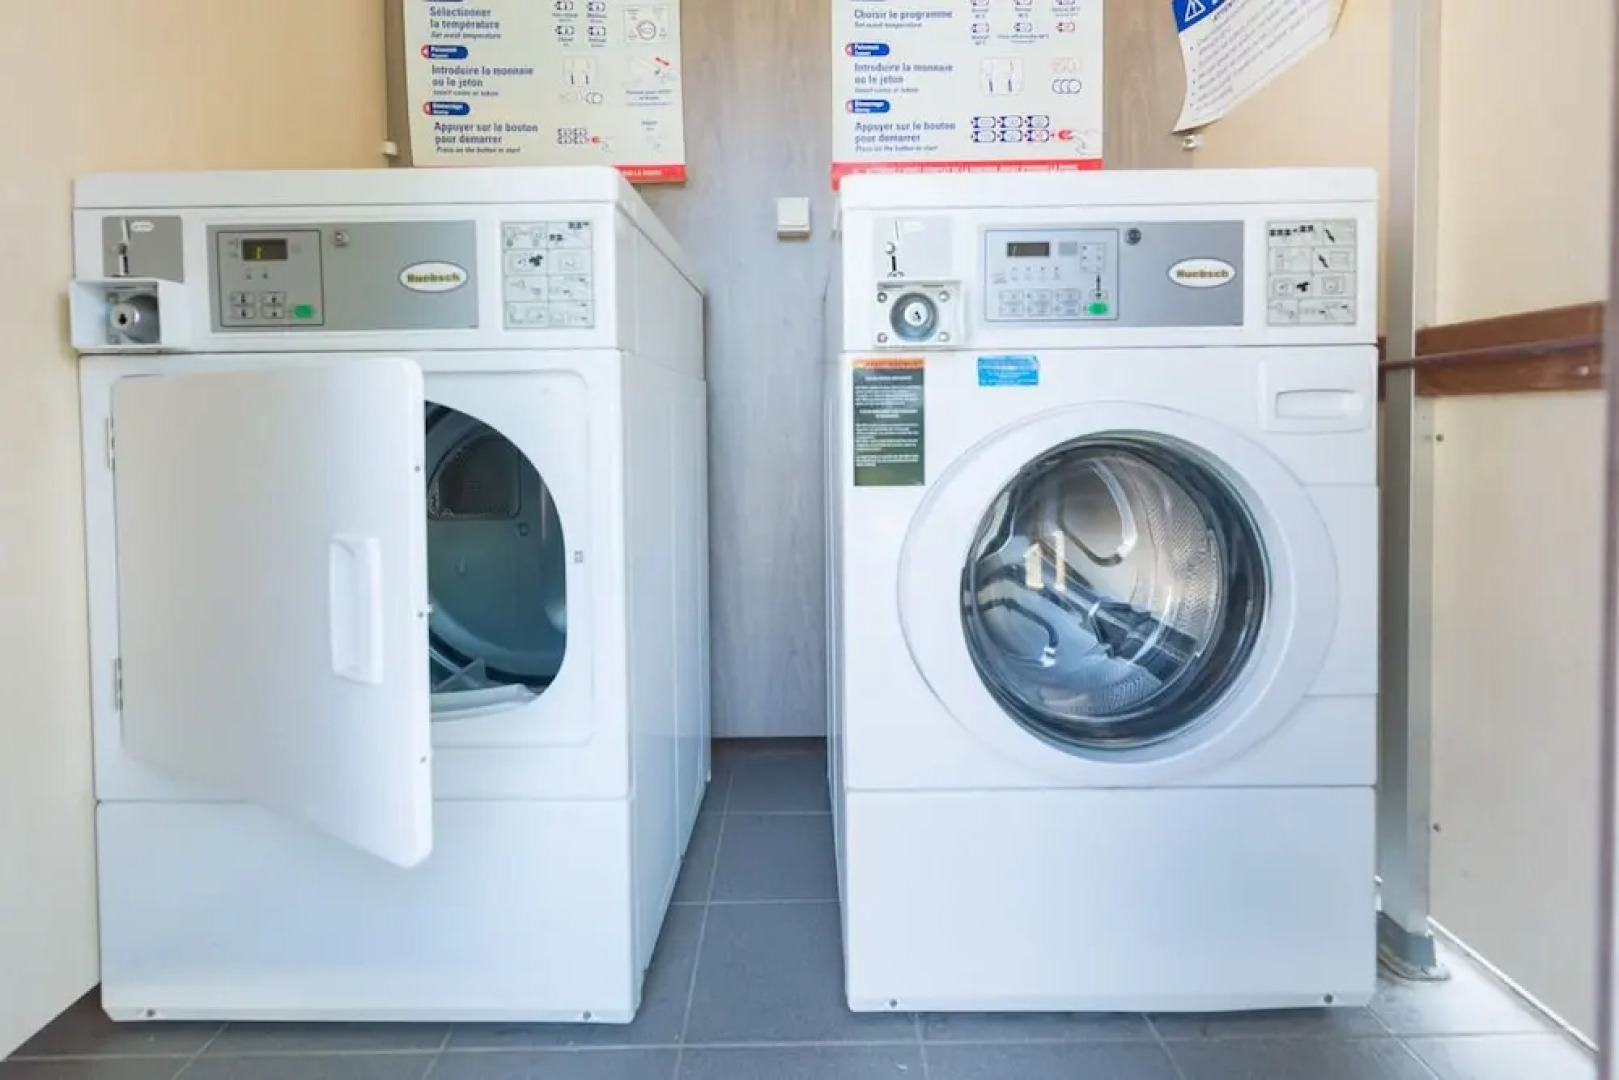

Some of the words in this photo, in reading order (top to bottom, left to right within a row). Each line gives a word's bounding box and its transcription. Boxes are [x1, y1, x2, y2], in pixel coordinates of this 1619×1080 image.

[429, 6, 492, 17] Sélectionner
[854, 9, 887, 19] Choisir
[889, 9, 898, 19] le
[900, 10, 953, 21] programme
[430, 19, 440, 28] la
[431, 65, 480, 75] Introduire
[482, 65, 491, 75] la
[493, 67, 534, 75] monnaie
[854, 62, 900, 72] Introduire
[902, 62, 911, 72] la
[913, 63, 953, 72] monnaie
[432, 78, 445, 87] ou
[446, 76, 456, 87] le
[458, 77, 483, 88] jeton
[854, 76, 867, 84] ou
[868, 74, 877, 84] le
[879, 75, 904, 86] jeton
[434, 121, 474, 133] Appuyer
[476, 123, 491, 132] sur
[493, 122, 502, 132] le
[505, 122, 539, 132] bouton
[854, 122, 893, 133] Appuyer
[896, 123, 911, 131] sur
[913, 121, 922, 131] le
[924, 121, 956, 131] bouton
[435, 136, 456, 145] pour
[854, 135, 876, 145] pour
[407, 272, 461, 283] Huebsch
[1176, 268, 1230, 279] Huebsch
